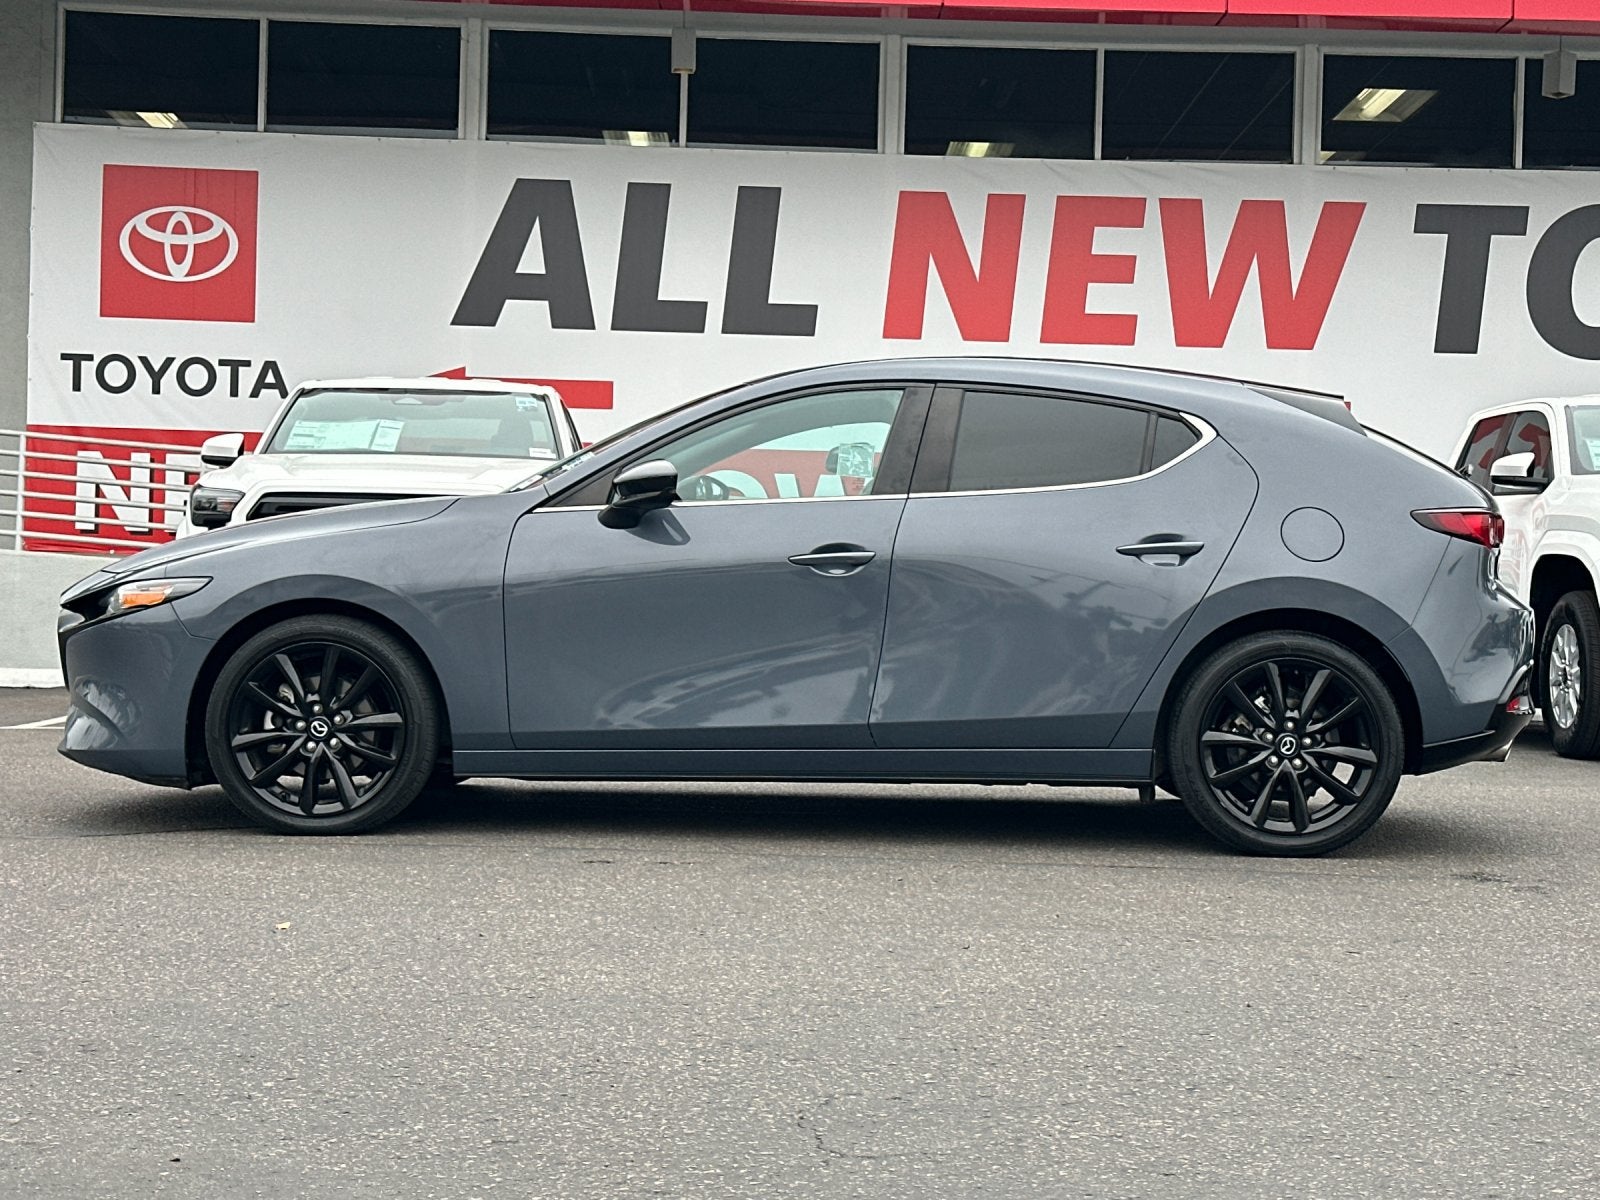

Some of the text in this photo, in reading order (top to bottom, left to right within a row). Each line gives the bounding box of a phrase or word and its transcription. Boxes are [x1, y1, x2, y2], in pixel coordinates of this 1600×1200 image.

[450, 178, 818, 336] ALL
[882, 191, 1365, 350] NEW
[60, 353, 289, 399] TOYOTA
